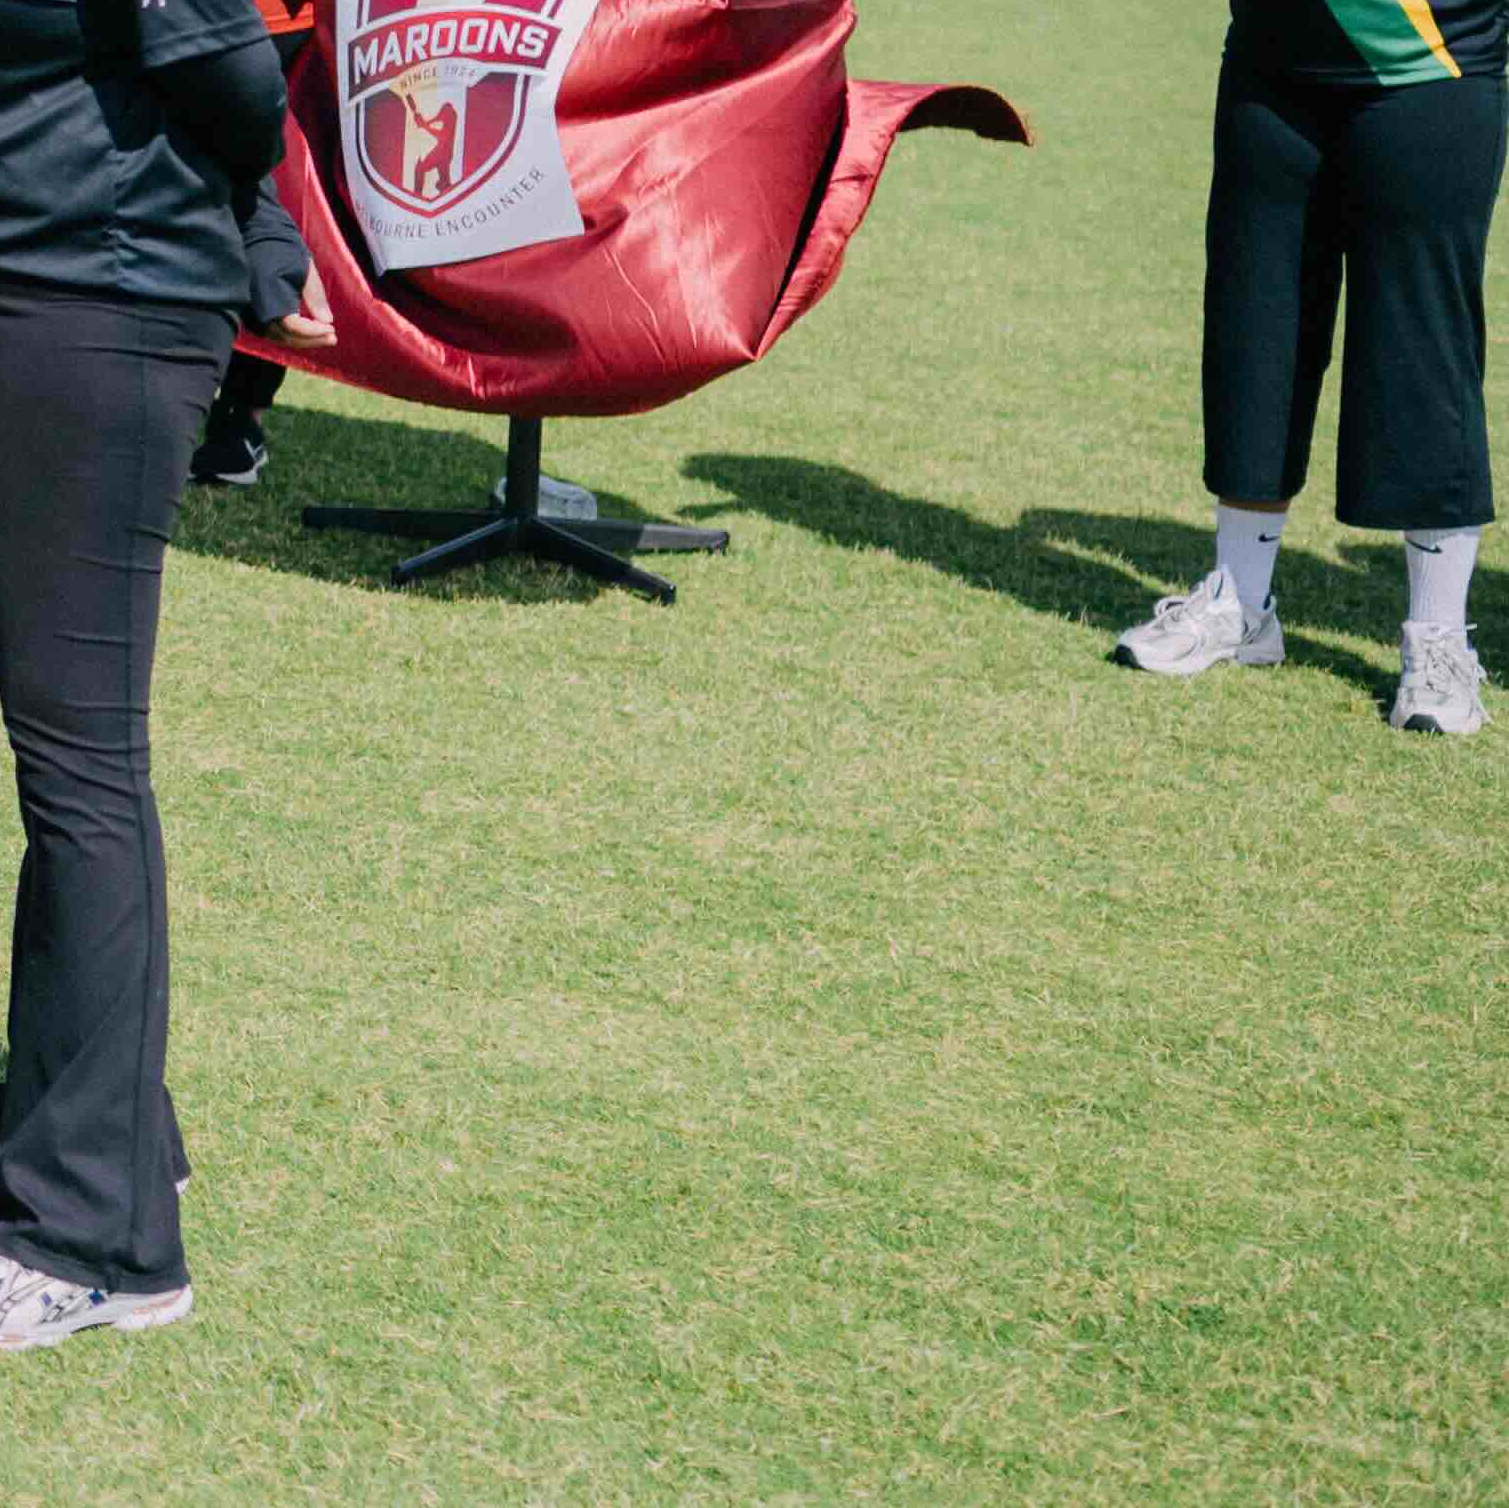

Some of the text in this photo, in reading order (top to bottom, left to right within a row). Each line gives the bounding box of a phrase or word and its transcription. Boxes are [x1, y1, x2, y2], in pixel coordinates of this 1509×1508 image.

[353, 17, 550, 85] MAROONS
[356, 166, 546, 238] BOURNE ENCOUNTER
